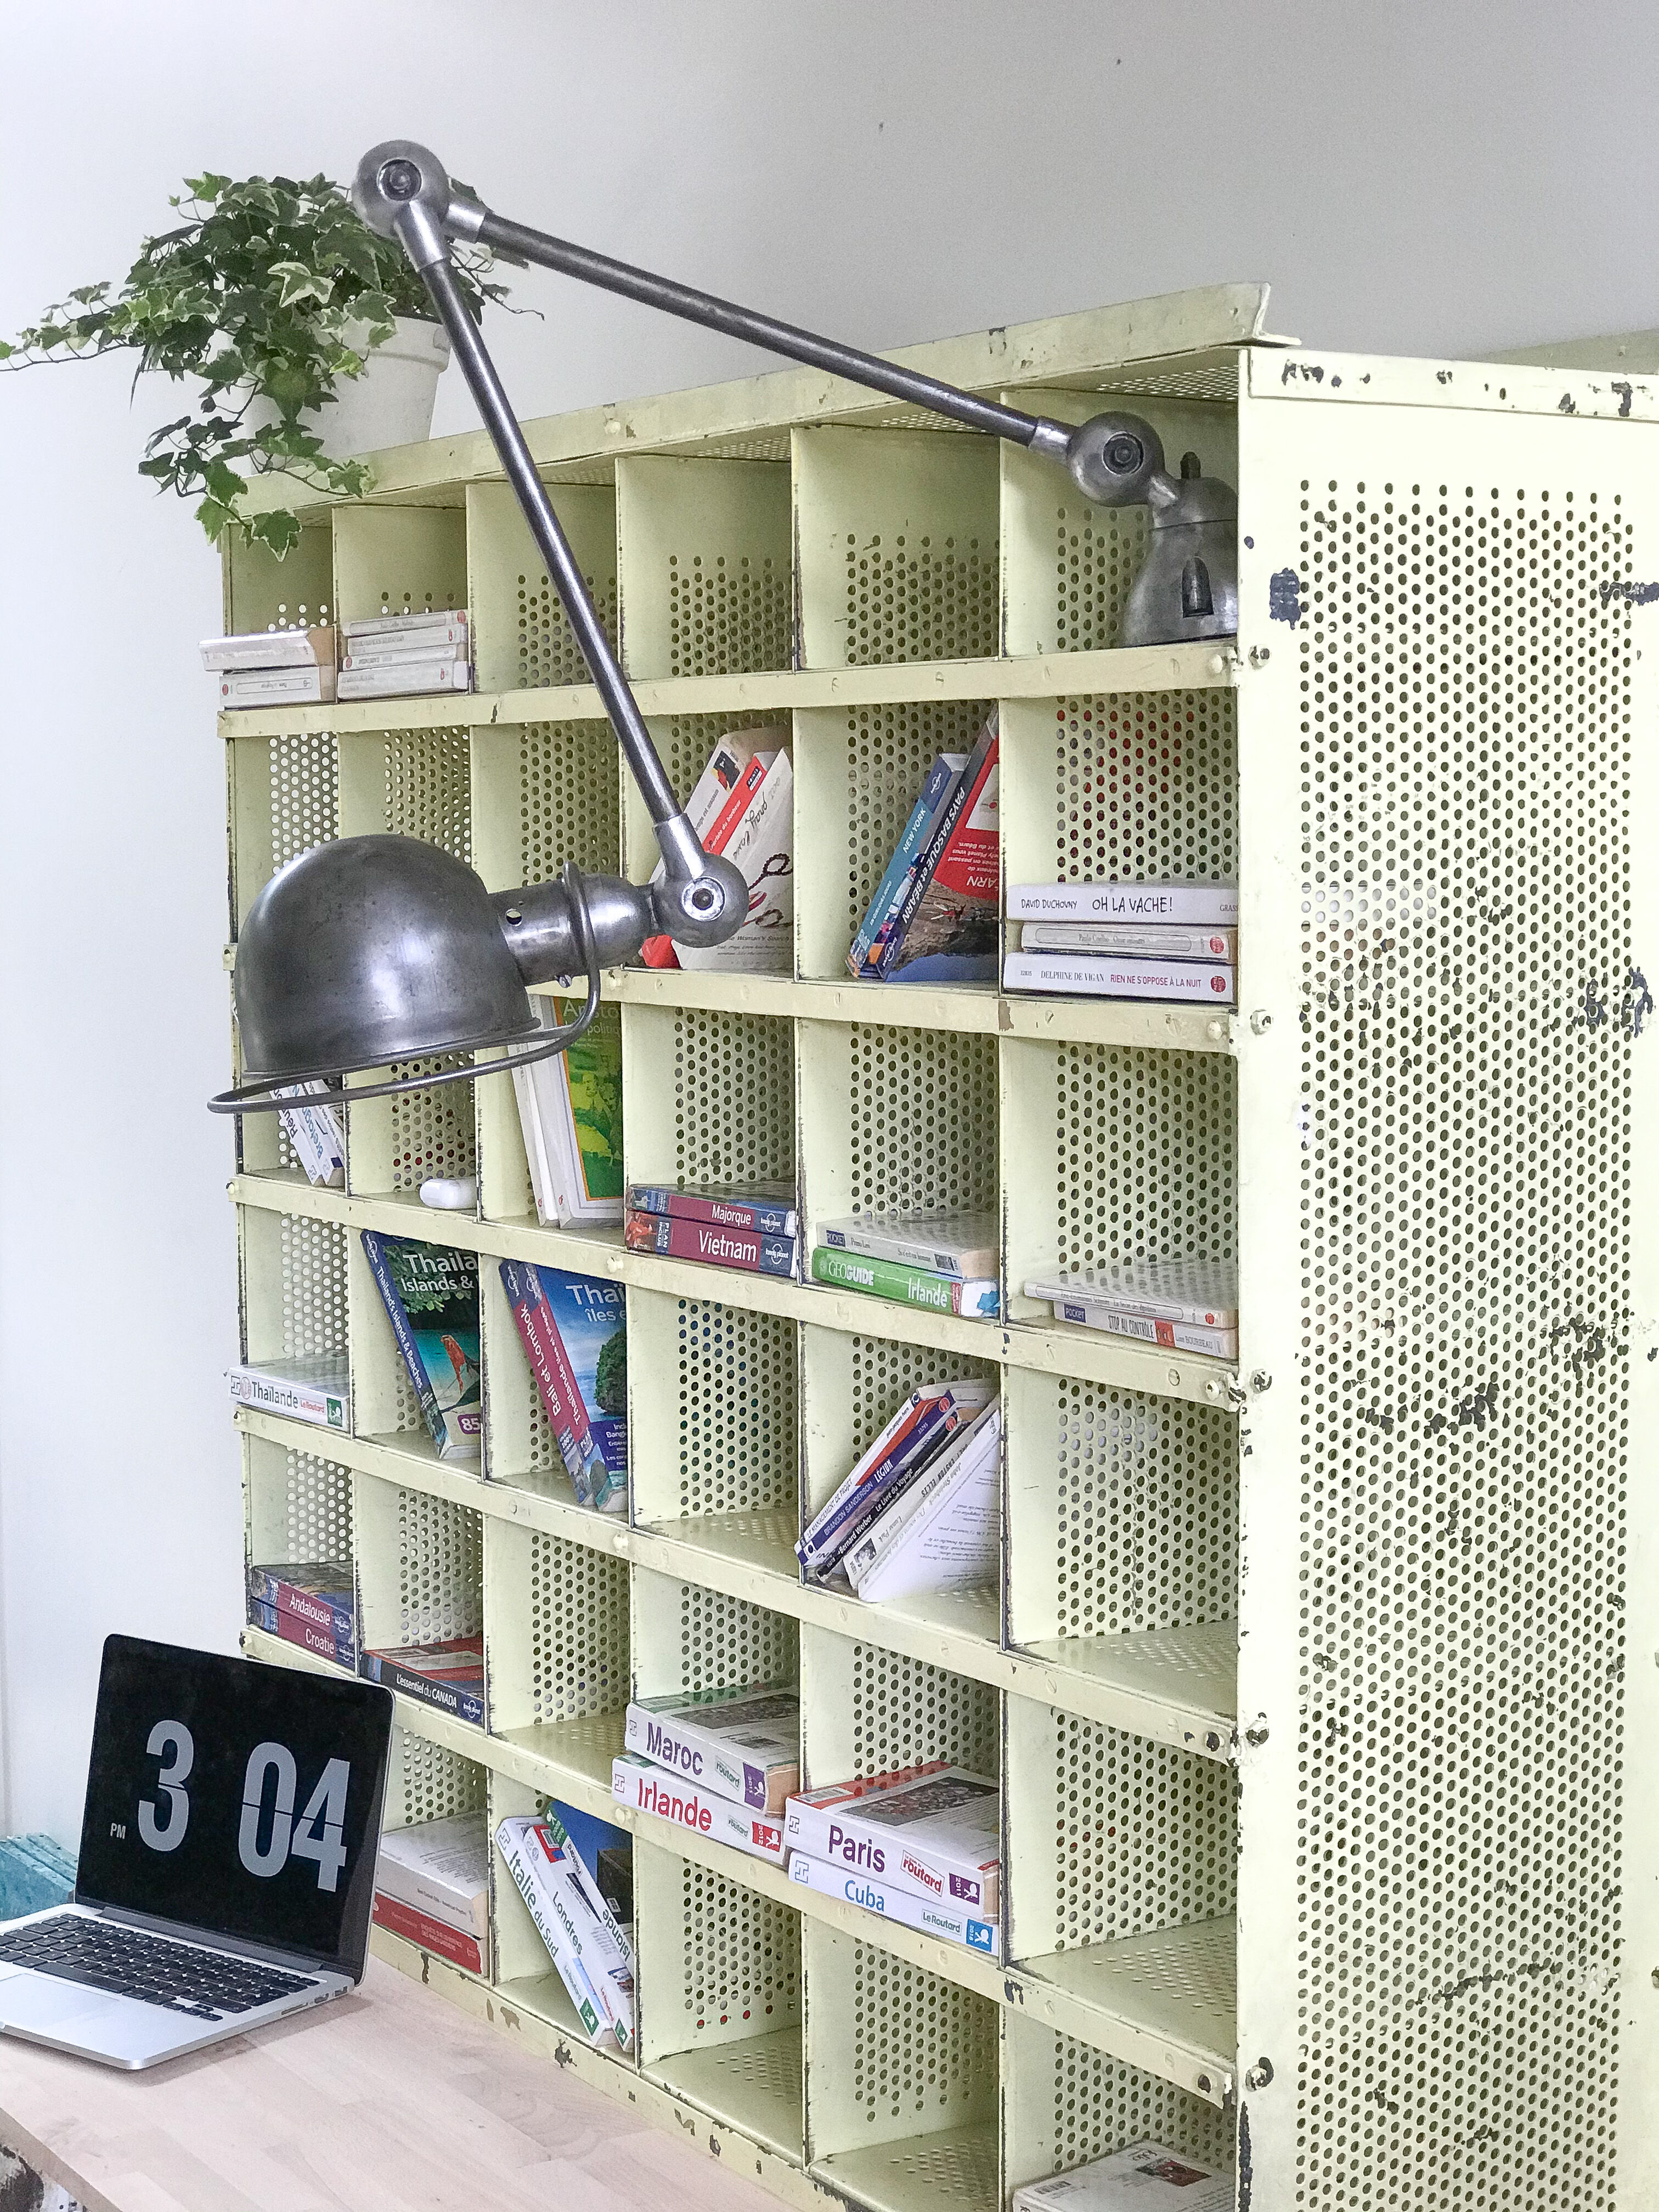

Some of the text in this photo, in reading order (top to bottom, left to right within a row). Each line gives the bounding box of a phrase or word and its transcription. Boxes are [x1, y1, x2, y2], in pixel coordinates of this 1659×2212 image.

[902, 808, 926, 854] NEW YORK
[902, 787, 965, 924] PAYS BASQUE et BÉARN
[966, 876, 997, 888] ARN
[1021, 898, 1040, 909] DAVID
[1042, 899, 1077, 910] DUCHOVNY
[1092, 897, 1107, 911] OH
[1112, 897, 1125, 913] LA
[1041, 970, 1073, 980] DELPHINE
[1074, 972, 1083, 981] DE
[1084, 972, 1104, 982] VIGAN
[1110, 974, 1125, 983] RIEN
[1137, 976, 1168, 986] S'OPPOSE
[1176, 979, 1184, 987] LA
[1186, 979, 1201, 988] NUIT
[712, 1204, 752, 1225] Majorque
[699, 1229, 757, 1262] Vietnam
[401, 1275, 475, 1293] Islands &
[566, 1284, 625, 1306] Thaï
[828, 1261, 874, 1286] GEOGUIDE
[908, 1278, 947, 1308] Irlande
[377, 1266, 396, 1314] Thailand's
[392, 1310, 407, 1342] Islands
[407, 1350, 422, 1389] Beaches
[585, 1308, 616, 1323] îles
[1065, 1308, 1085, 1321] POCKET
[1108, 1315, 1120, 1330] STOP
[1121, 1318, 1128, 1333] AU
[520, 1304, 561, 1416] Bali et Lombok
[252, 1381, 298, 1409] Thaïlande
[922, 1479, 937, 1497] ELLIS
[825, 1510, 846, 1536] BRANDON
[844, 1483, 873, 1514] SANDERSON
[839, 1531, 857, 1555] Bernard
[855, 1514, 873, 1534] Werber
[875, 1504, 883, 1513] Le
[881, 1491, 893, 1506] Livre
[891, 1485, 899, 1494] du
[897, 1468, 913, 1487] Voyage
[289, 1593, 331, 1627] Andalousie
[305, 1628, 335, 1655] Croatie
[396, 1673, 457, 1708] L'essentiel du CANADA
[646, 1722, 740, 1787] Maroc routard
[138, 1719, 351, 1893] 3 04
[638, 1778, 749, 1837] Irlande routard
[110, 1822, 126, 1840] PM
[829, 1825, 885, 1873] Paris
[903, 1858, 943, 1893] routard
[508, 1850, 537, 1909] Italie
[534, 1910, 545, 1932] du
[543, 1927, 559, 1959] Sud
[845, 1880, 885, 1912] Cuba
[932, 1915, 961, 1933] Routard
[551, 1891, 583, 1956] Londres
[602, 1909, 631, 1962] Islande
